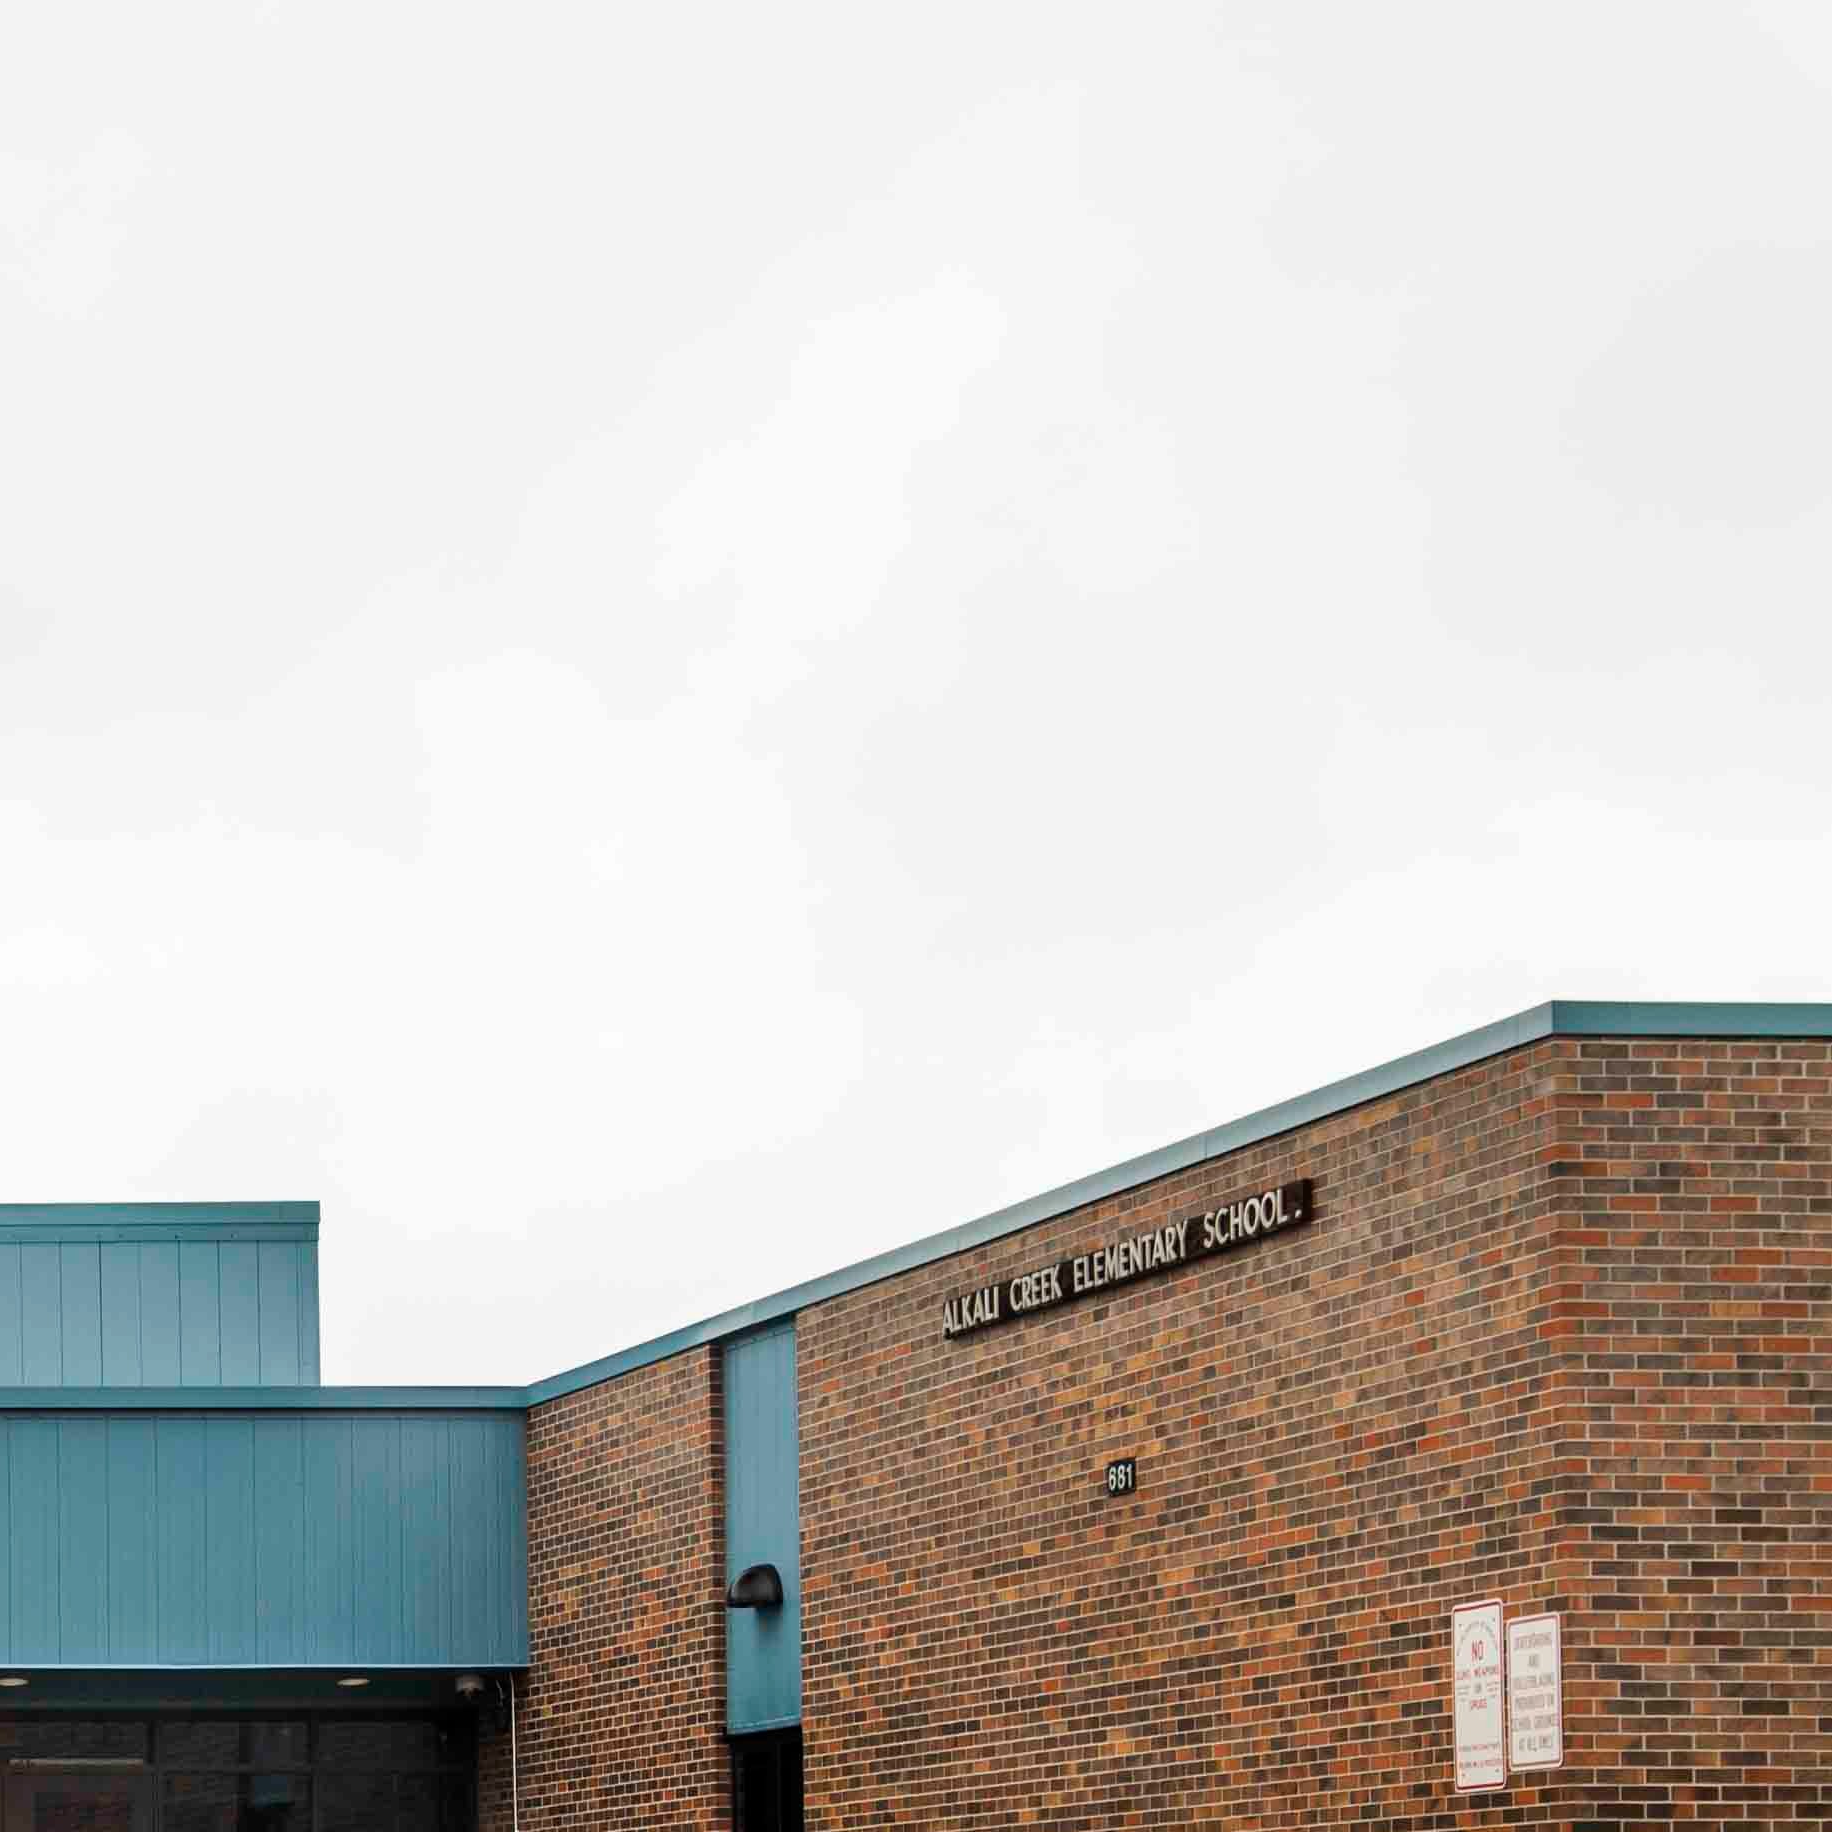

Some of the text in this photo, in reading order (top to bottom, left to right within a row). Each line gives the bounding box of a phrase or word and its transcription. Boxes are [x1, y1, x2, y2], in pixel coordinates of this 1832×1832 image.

[943, 1286, 1000, 1334] ALKALI
[1010, 1264, 1063, 1312] CREEK
[1073, 1217, 1188, 1294] ELEMENTARY
[1108, 1463, 1133, 1492] 681
[1471, 1639, 1484, 1663] NO
